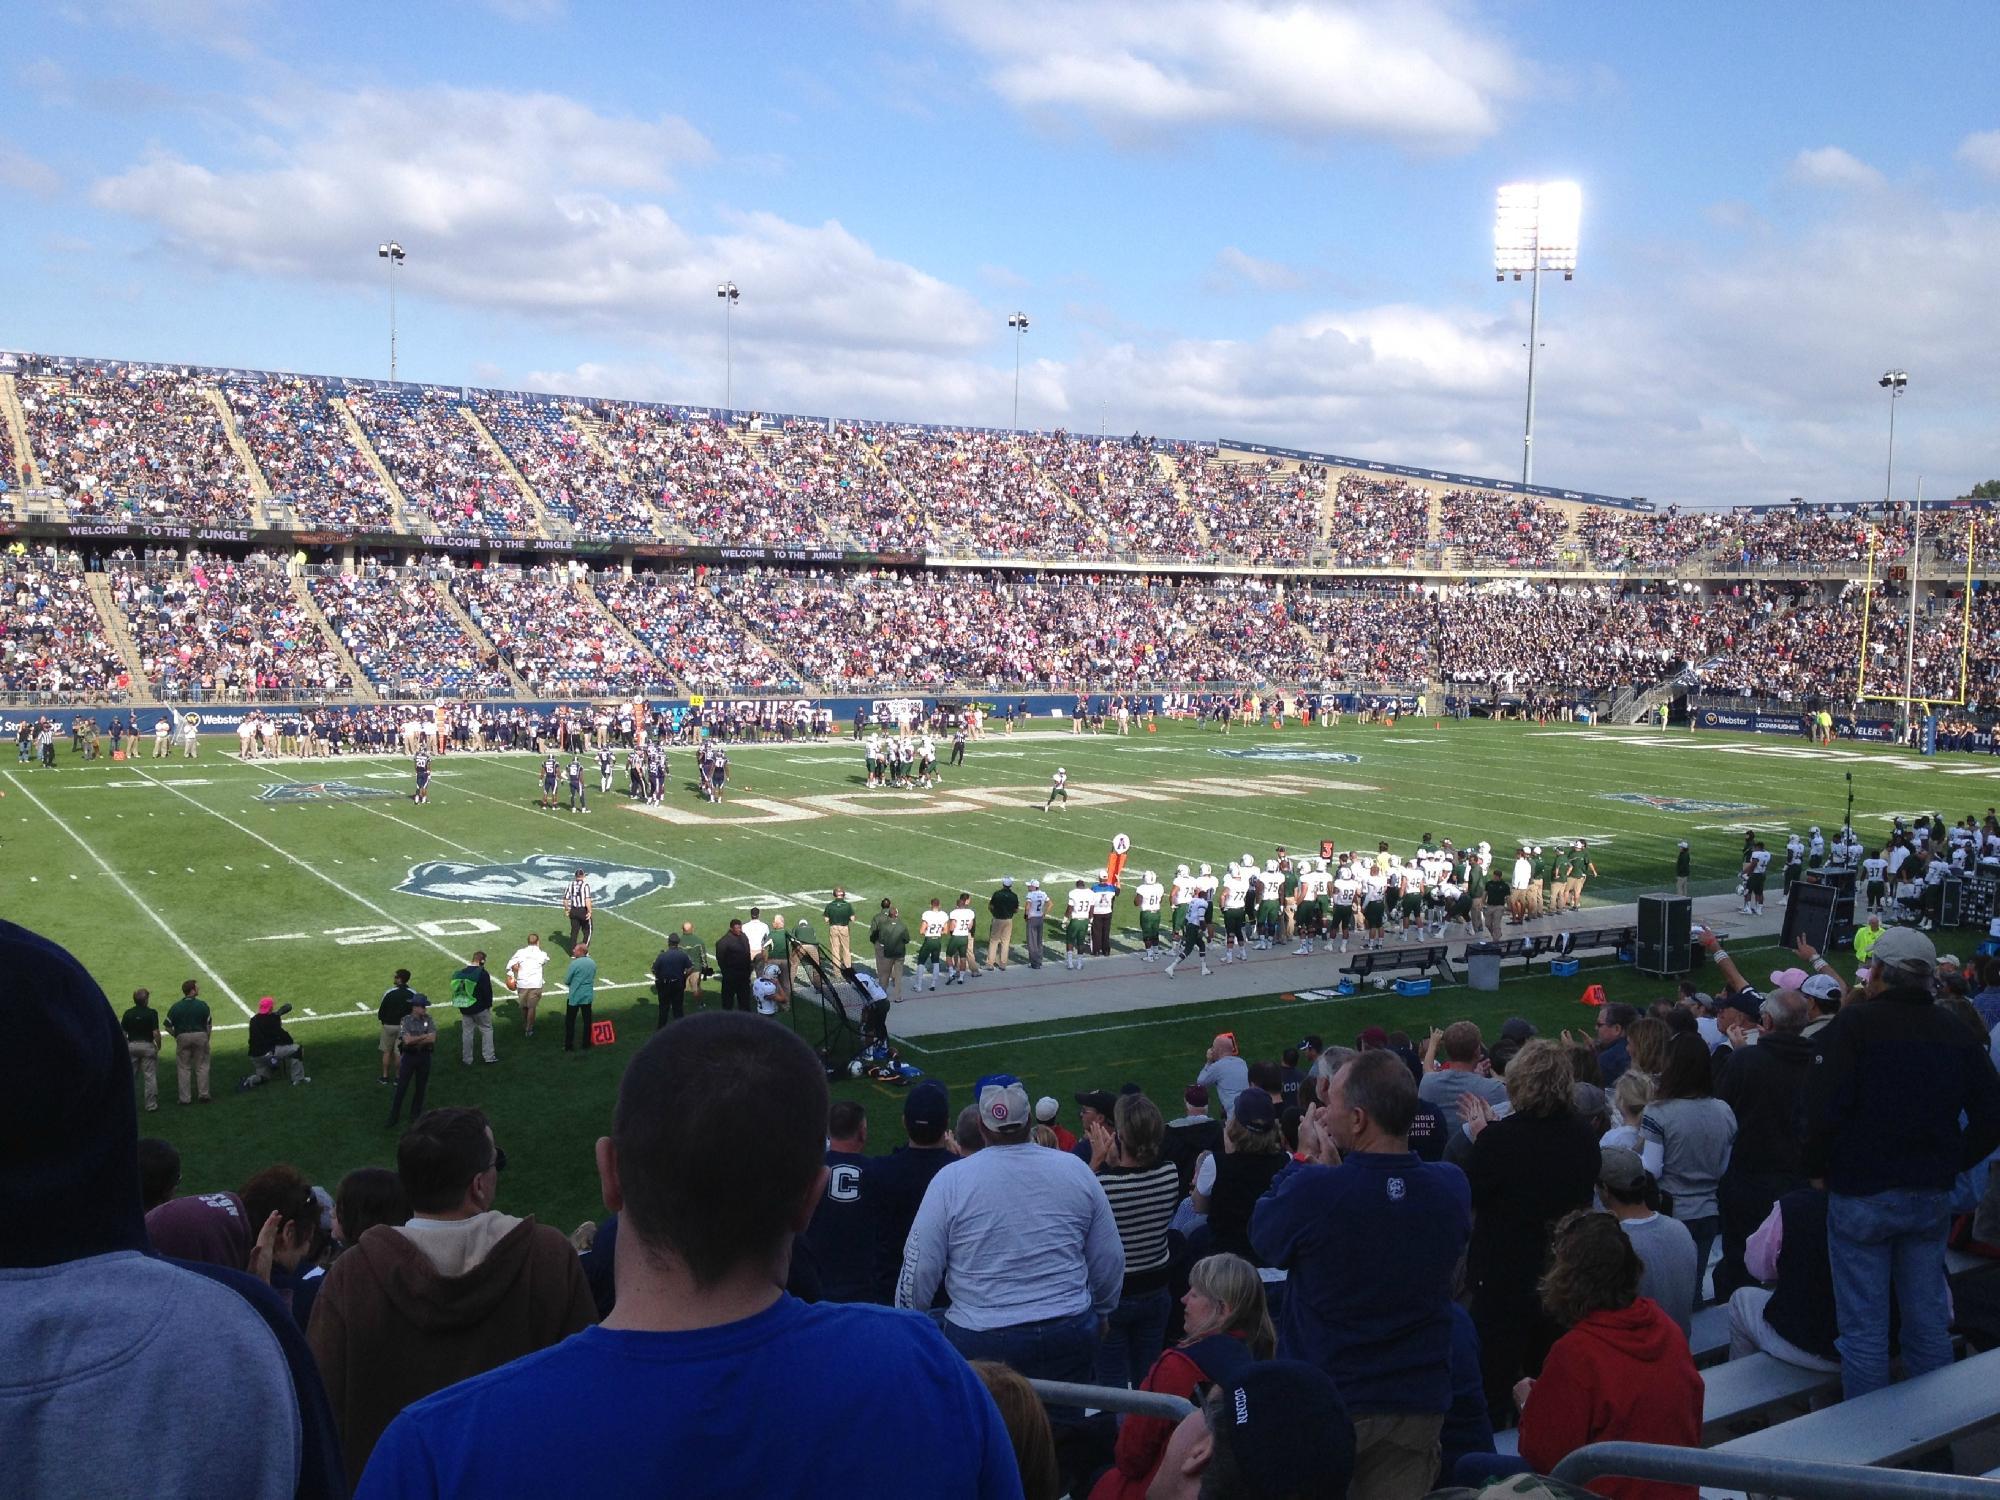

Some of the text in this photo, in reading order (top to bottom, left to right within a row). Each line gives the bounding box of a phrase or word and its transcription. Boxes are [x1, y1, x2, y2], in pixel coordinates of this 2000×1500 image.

[68, 525, 248, 541] WELCOME TO THE JUNGLE
[422, 535, 572, 550] WELCOME TO THE JUNGLE
[721, 549, 843, 561] WELCOME TO THE JUNGLE
[202, 715, 241, 725] Webster
[1718, 715, 1747, 725] Webster
[416, 758, 426, 768] 20
[618, 775, 1382, 825] UCONN
[1116, 838, 1127, 851] A
[1323, 842, 1333, 858] 3
[1869, 867, 1880, 877] 37
[1268, 882, 1278, 892] 75
[1343, 889, 1354, 900] 82
[1036, 900, 1042, 911] 2
[1078, 900, 1089, 912] 33
[323, 918, 501, 945] 20
[929, 923, 941, 934] 27
[594, 1023, 612, 1043] 20
[828, 1164, 863, 1202] C
[1234, 1387, 1249, 1425] UCONN
